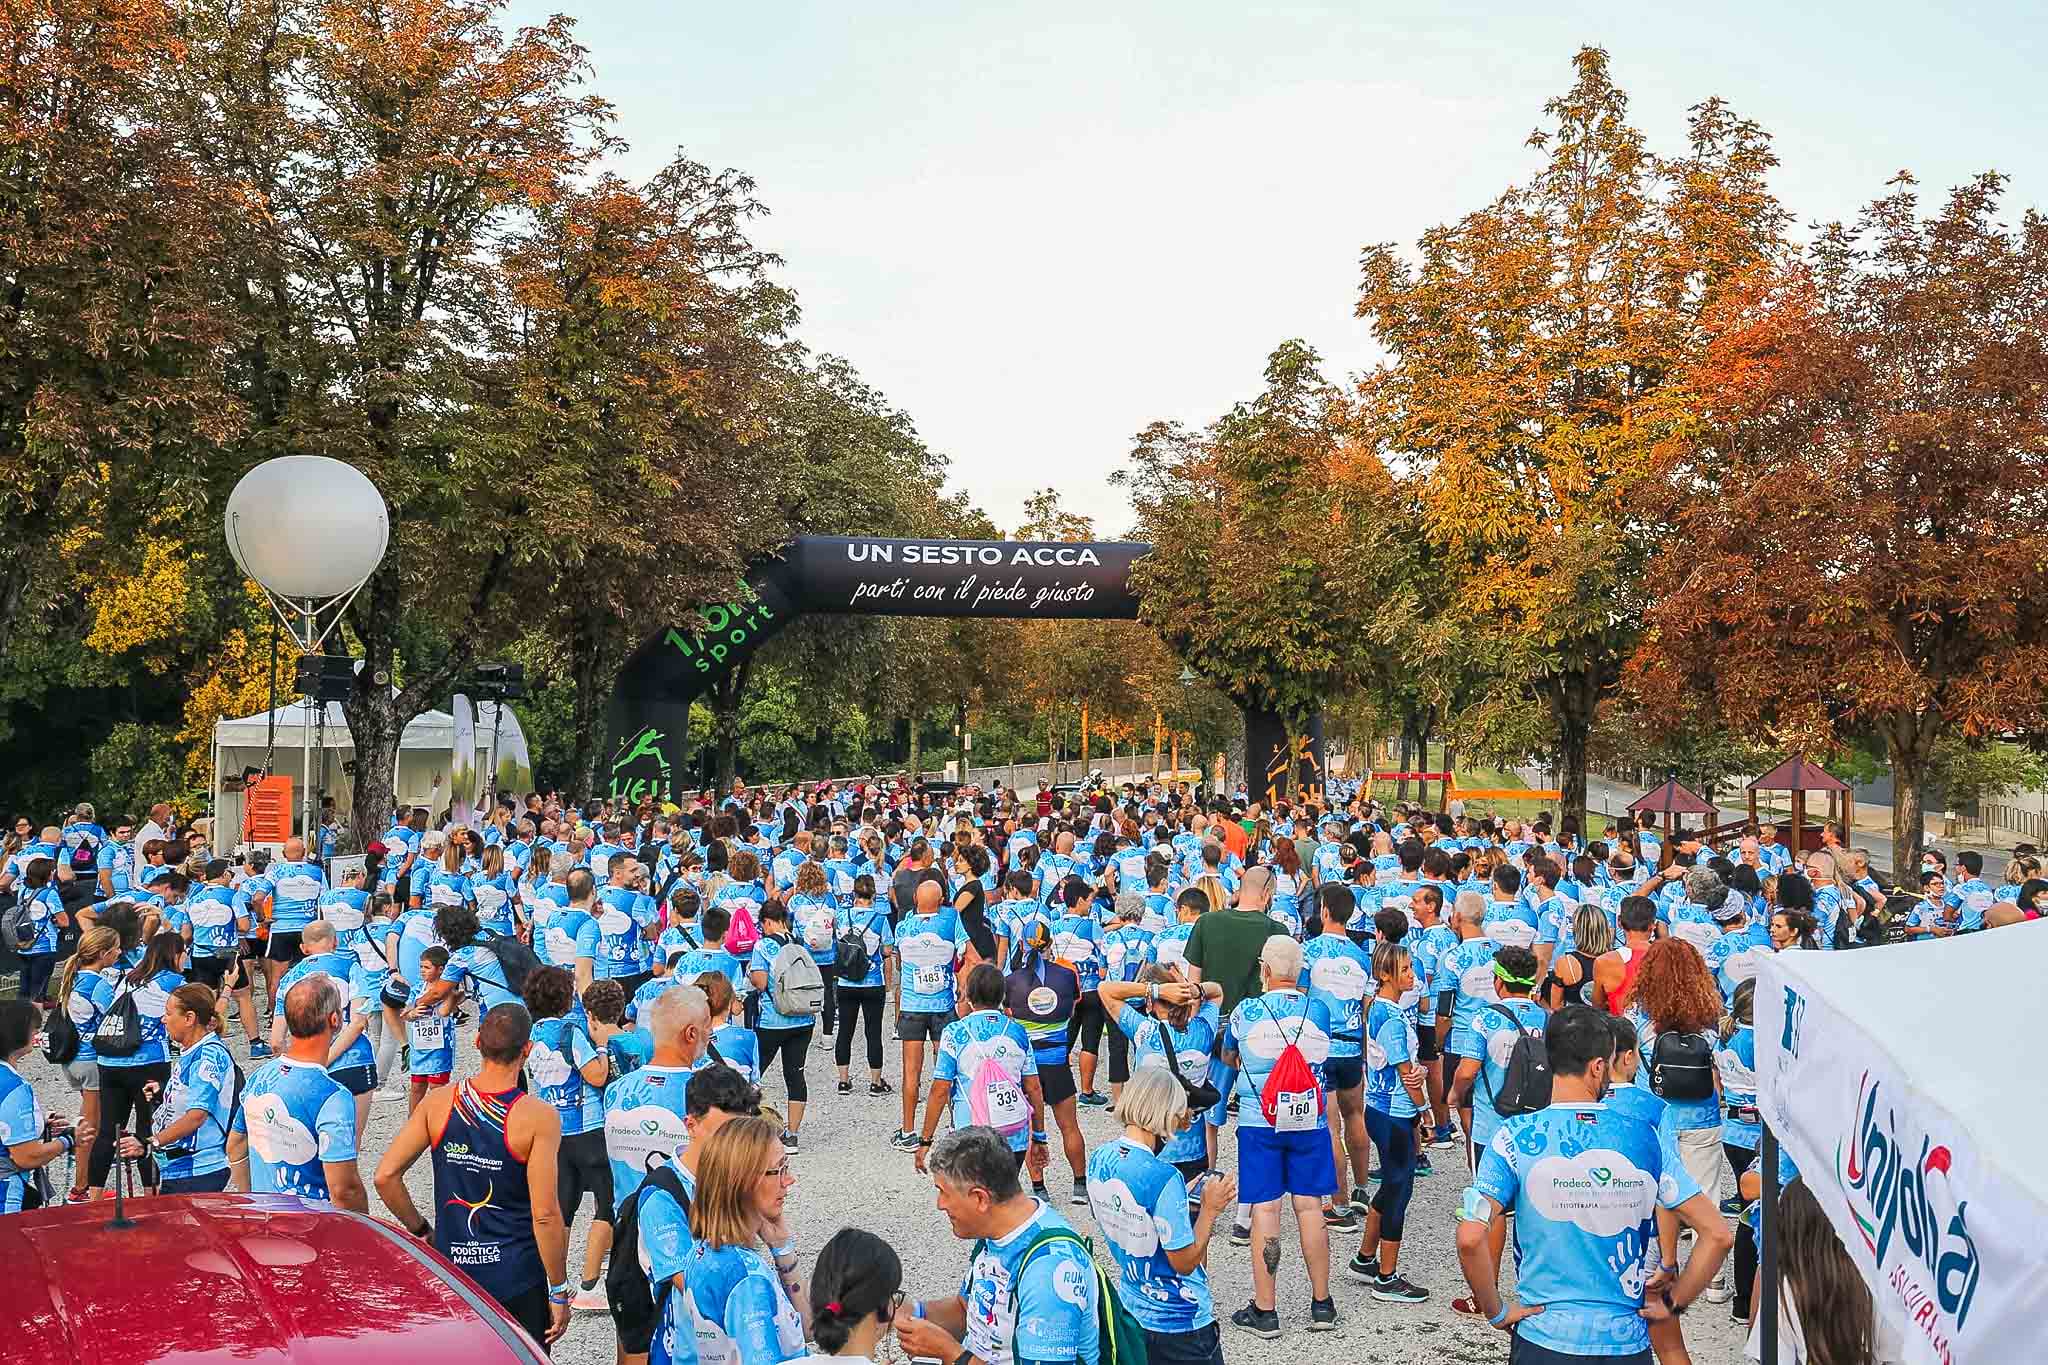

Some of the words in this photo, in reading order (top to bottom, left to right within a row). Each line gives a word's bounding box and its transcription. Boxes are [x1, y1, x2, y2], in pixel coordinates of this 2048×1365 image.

[848, 543, 893, 563] UN
[902, 545, 1002, 566] SESTO
[1010, 547, 1101, 567] ACCA
[850, 577, 910, 606] parti
[913, 584, 946, 601] con
[953, 574, 977, 600] il
[971, 576, 1029, 609] piede
[1030, 581, 1096, 609] giusto
[695, 604, 774, 673] sport
[416, 1026, 439, 1037] 1280
[996, 1089, 1018, 1107] 339
[1288, 1101, 1310, 1117] 160
[1553, 1178, 1592, 1189] Prodeco
[1612, 1178, 1644, 1188] Pharma
[450, 1245, 501, 1256] PODISTICA
[453, 1254, 501, 1265] MAGLIESE
